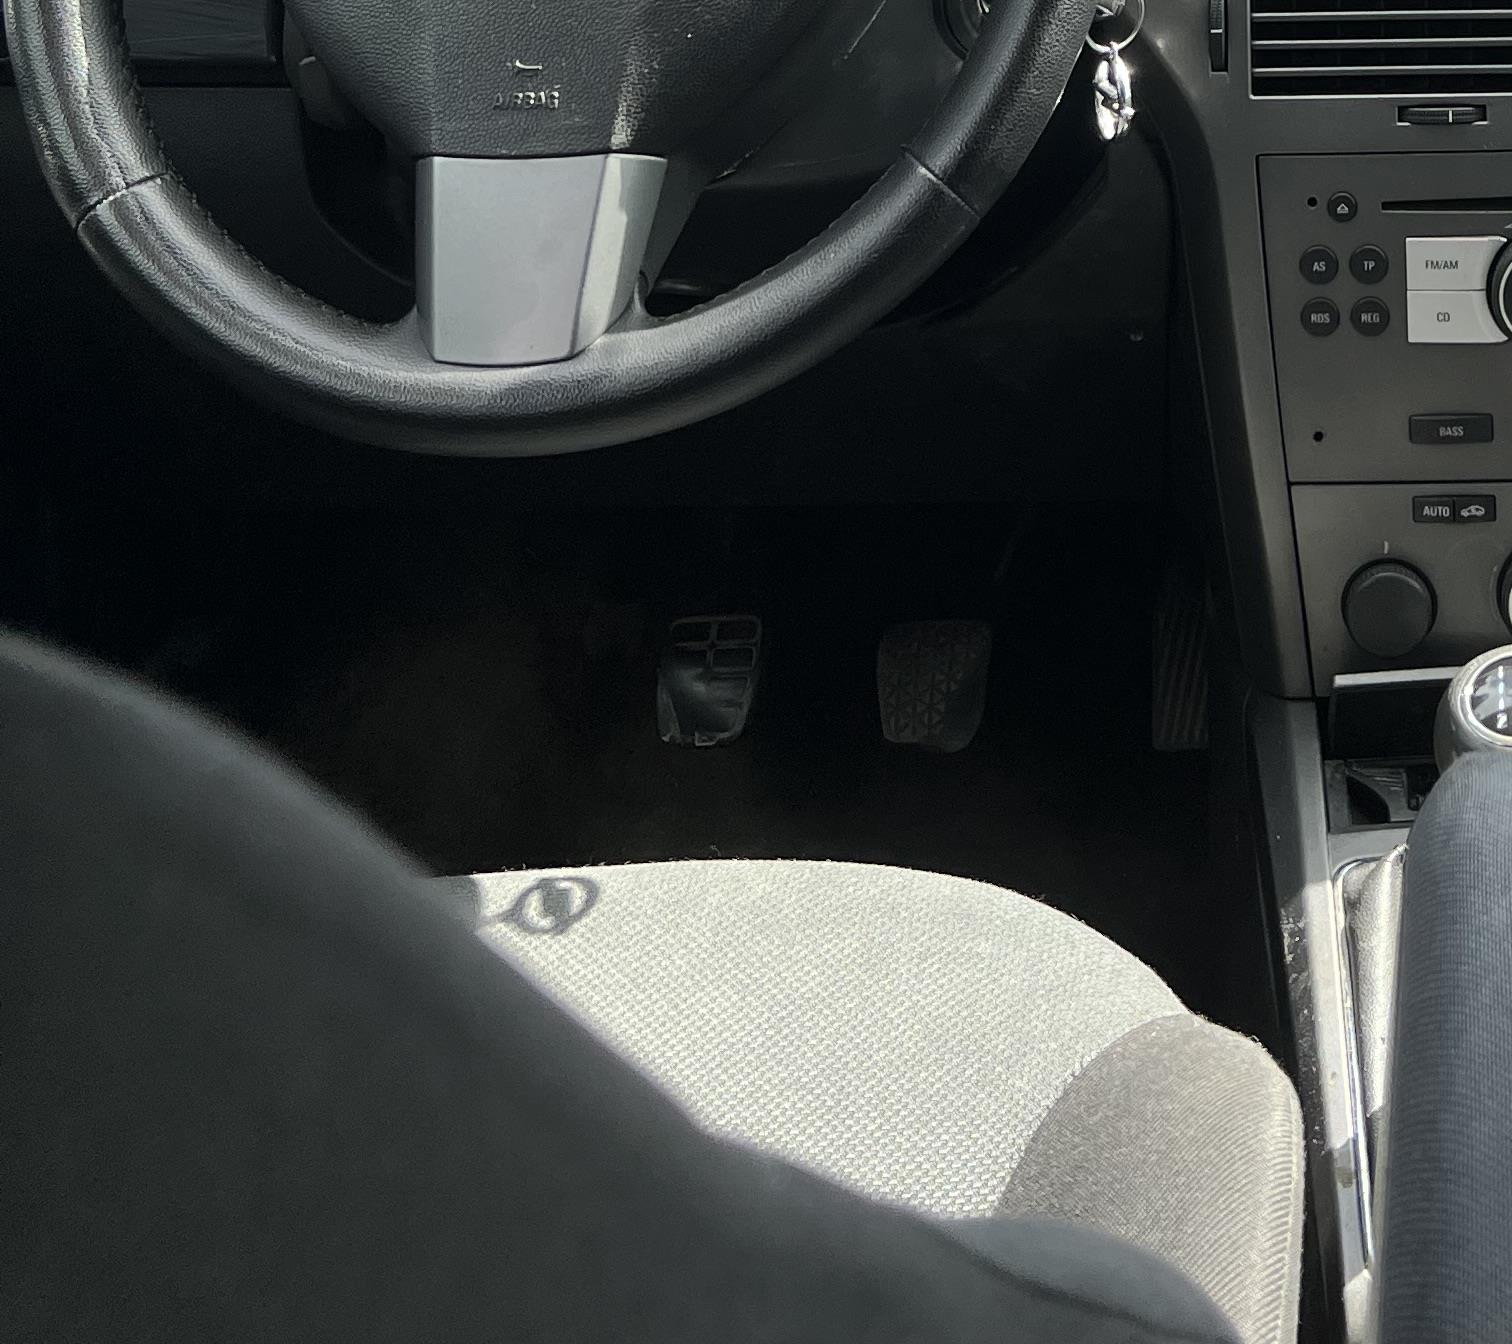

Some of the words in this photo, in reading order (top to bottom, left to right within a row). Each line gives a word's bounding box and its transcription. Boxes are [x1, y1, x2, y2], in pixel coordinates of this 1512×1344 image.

[1312, 261, 1326, 272] AS
[1363, 261, 1376, 272] TP
[1425, 259, 1459, 270] FM/AM
[1310, 313, 1331, 324] RDS
[1361, 312, 1380, 323] REG
[1436, 312, 1450, 323] CD
[1438, 425, 1464, 437] BASS
[1422, 505, 1450, 517] AUTO
